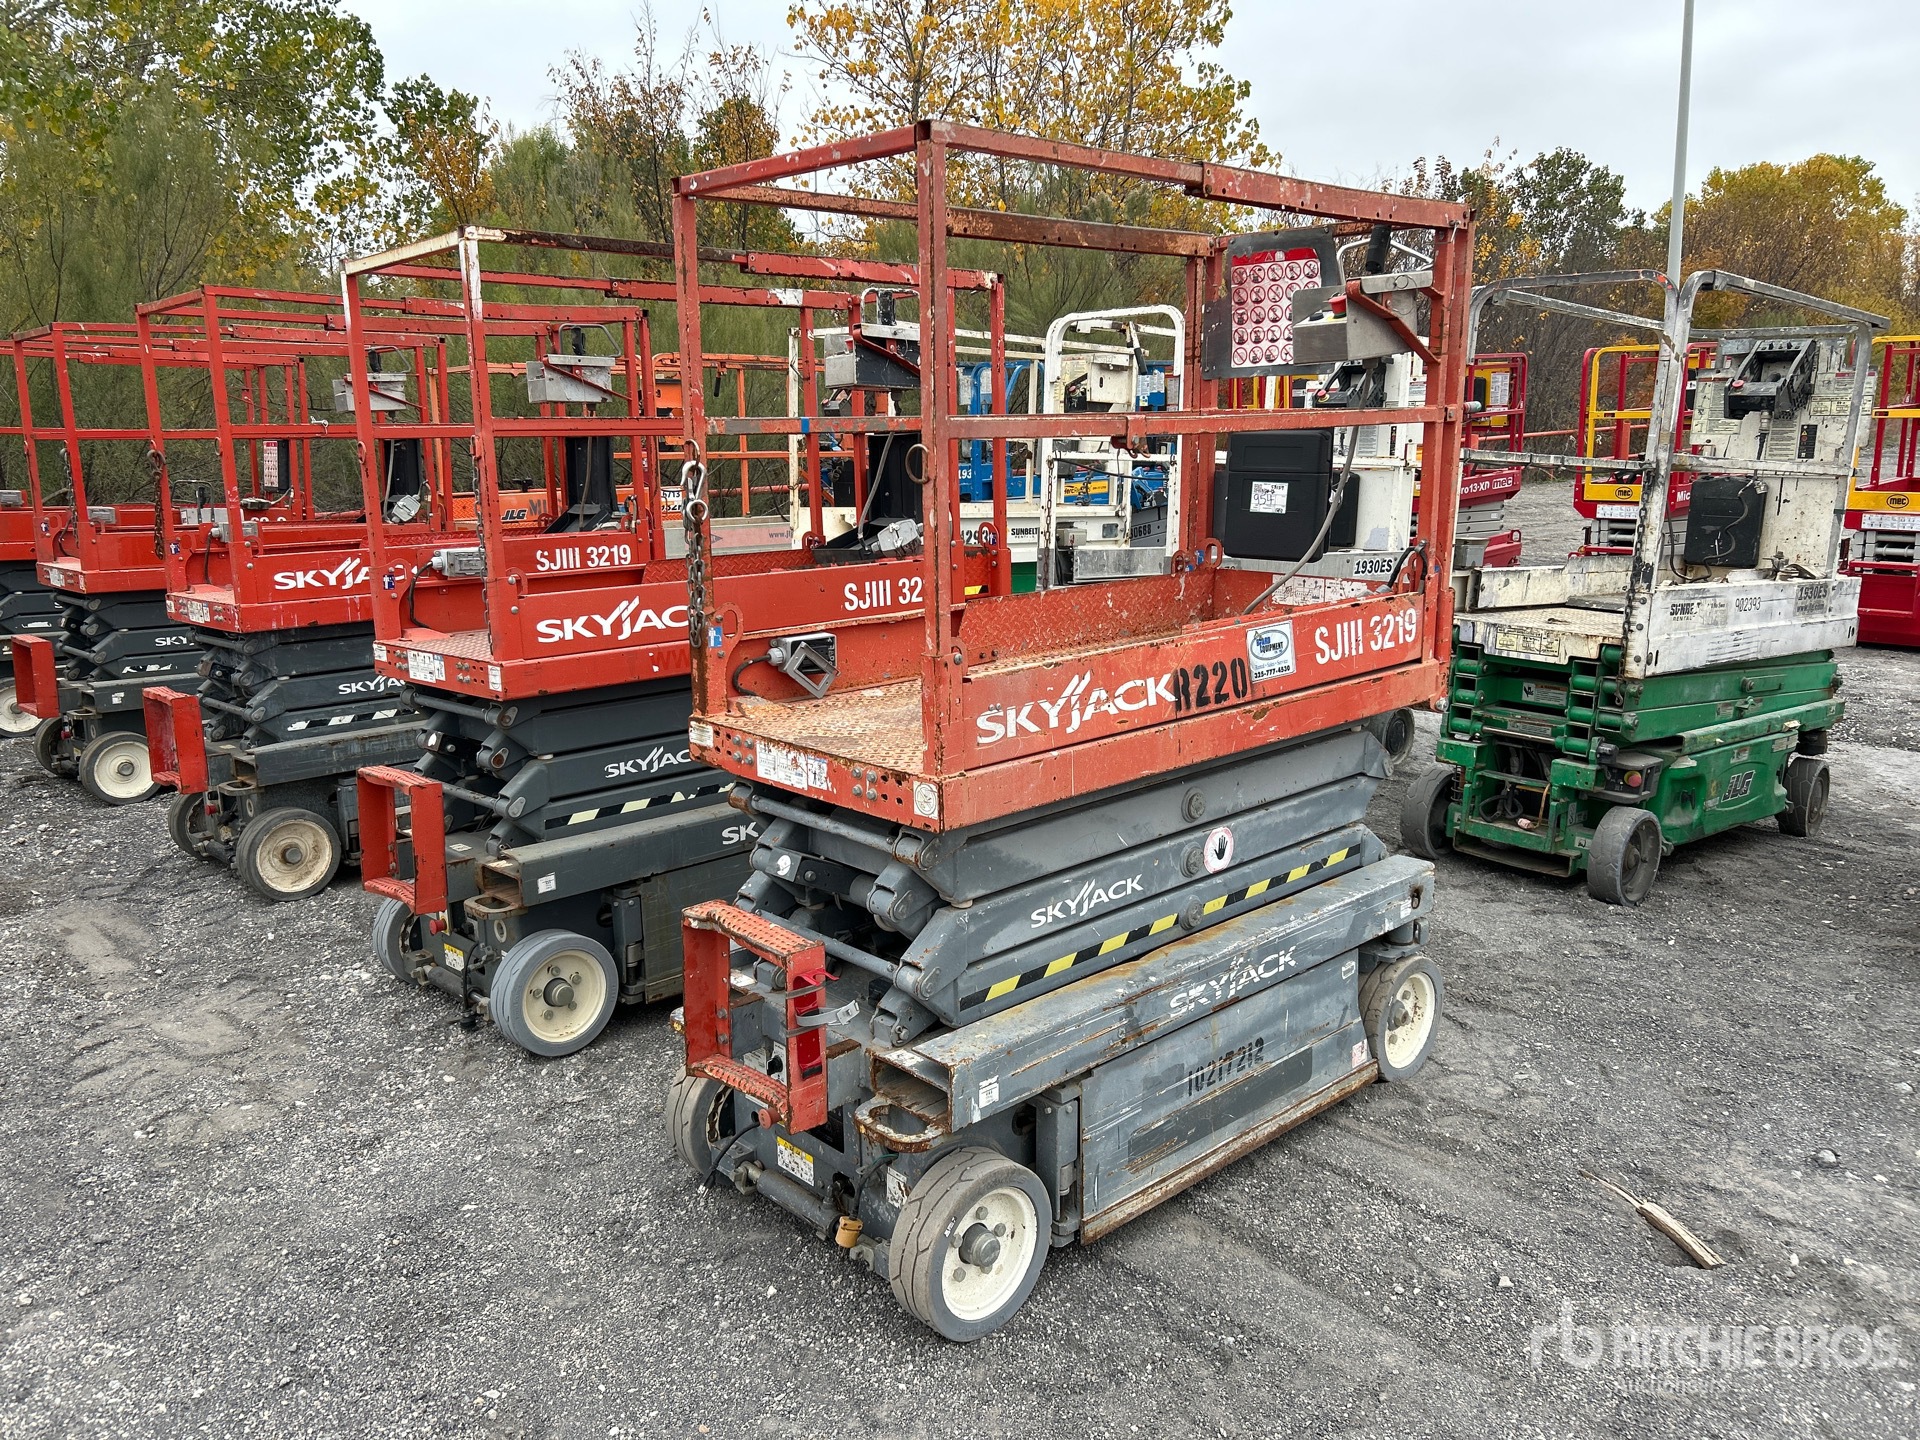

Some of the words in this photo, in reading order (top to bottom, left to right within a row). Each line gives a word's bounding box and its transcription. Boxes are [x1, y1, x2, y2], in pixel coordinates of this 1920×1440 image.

[501, 509, 528, 521] JLG
[1011, 527, 1038, 536] SUNBELT
[586, 544, 632, 568] 3219
[1354, 558, 1394, 575] 1930ES
[898, 576, 924, 605] 32
[1369, 607, 1418, 651] 3219
[975, 669, 1179, 745] SKYJACK
[1030, 873, 1145, 929] SKYJACK
[1169, 944, 1300, 1019] SKYJACK
